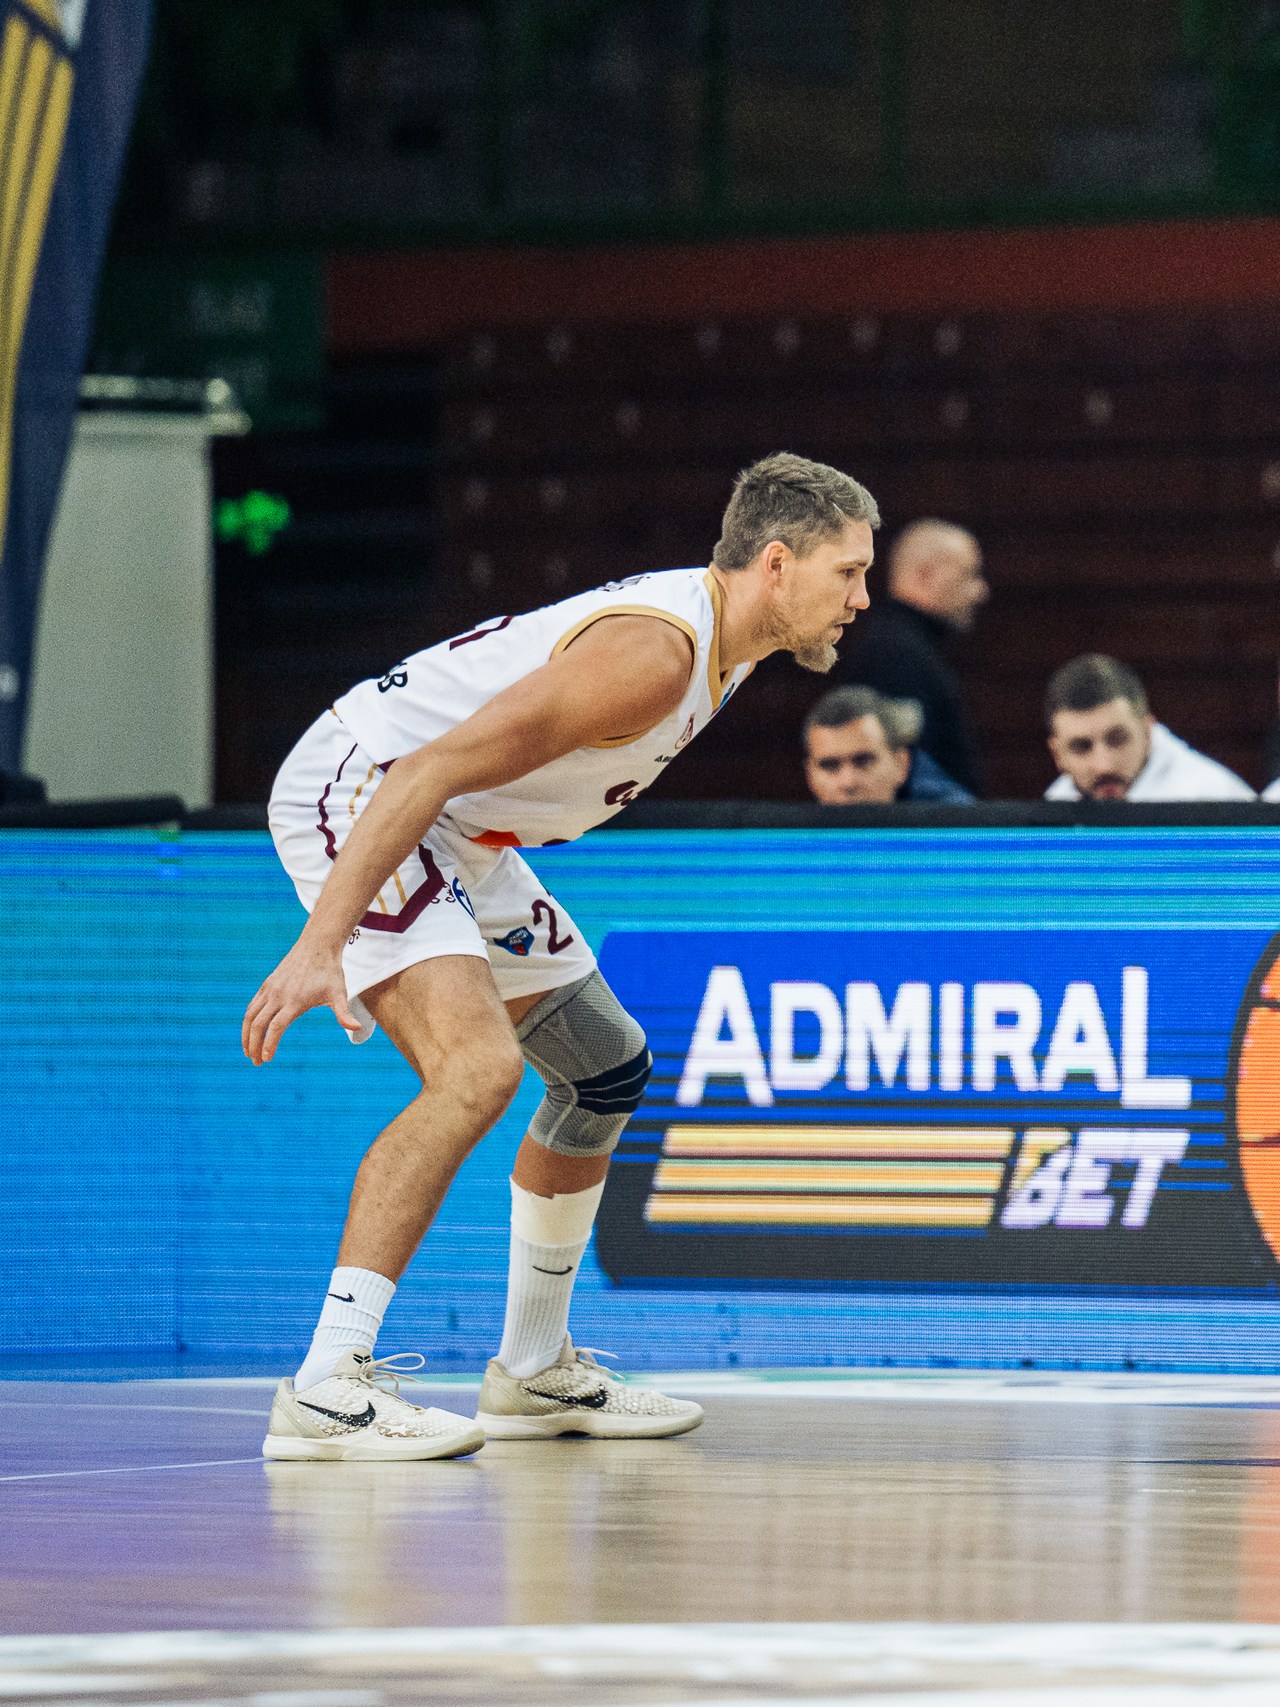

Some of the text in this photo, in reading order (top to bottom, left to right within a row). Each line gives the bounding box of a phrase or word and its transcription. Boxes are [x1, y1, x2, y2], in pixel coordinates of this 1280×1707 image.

[531, 898, 574, 955] 2
[675, 966, 1193, 1110] ADMIRAL
[1000, 1127, 1191, 1229] BET
